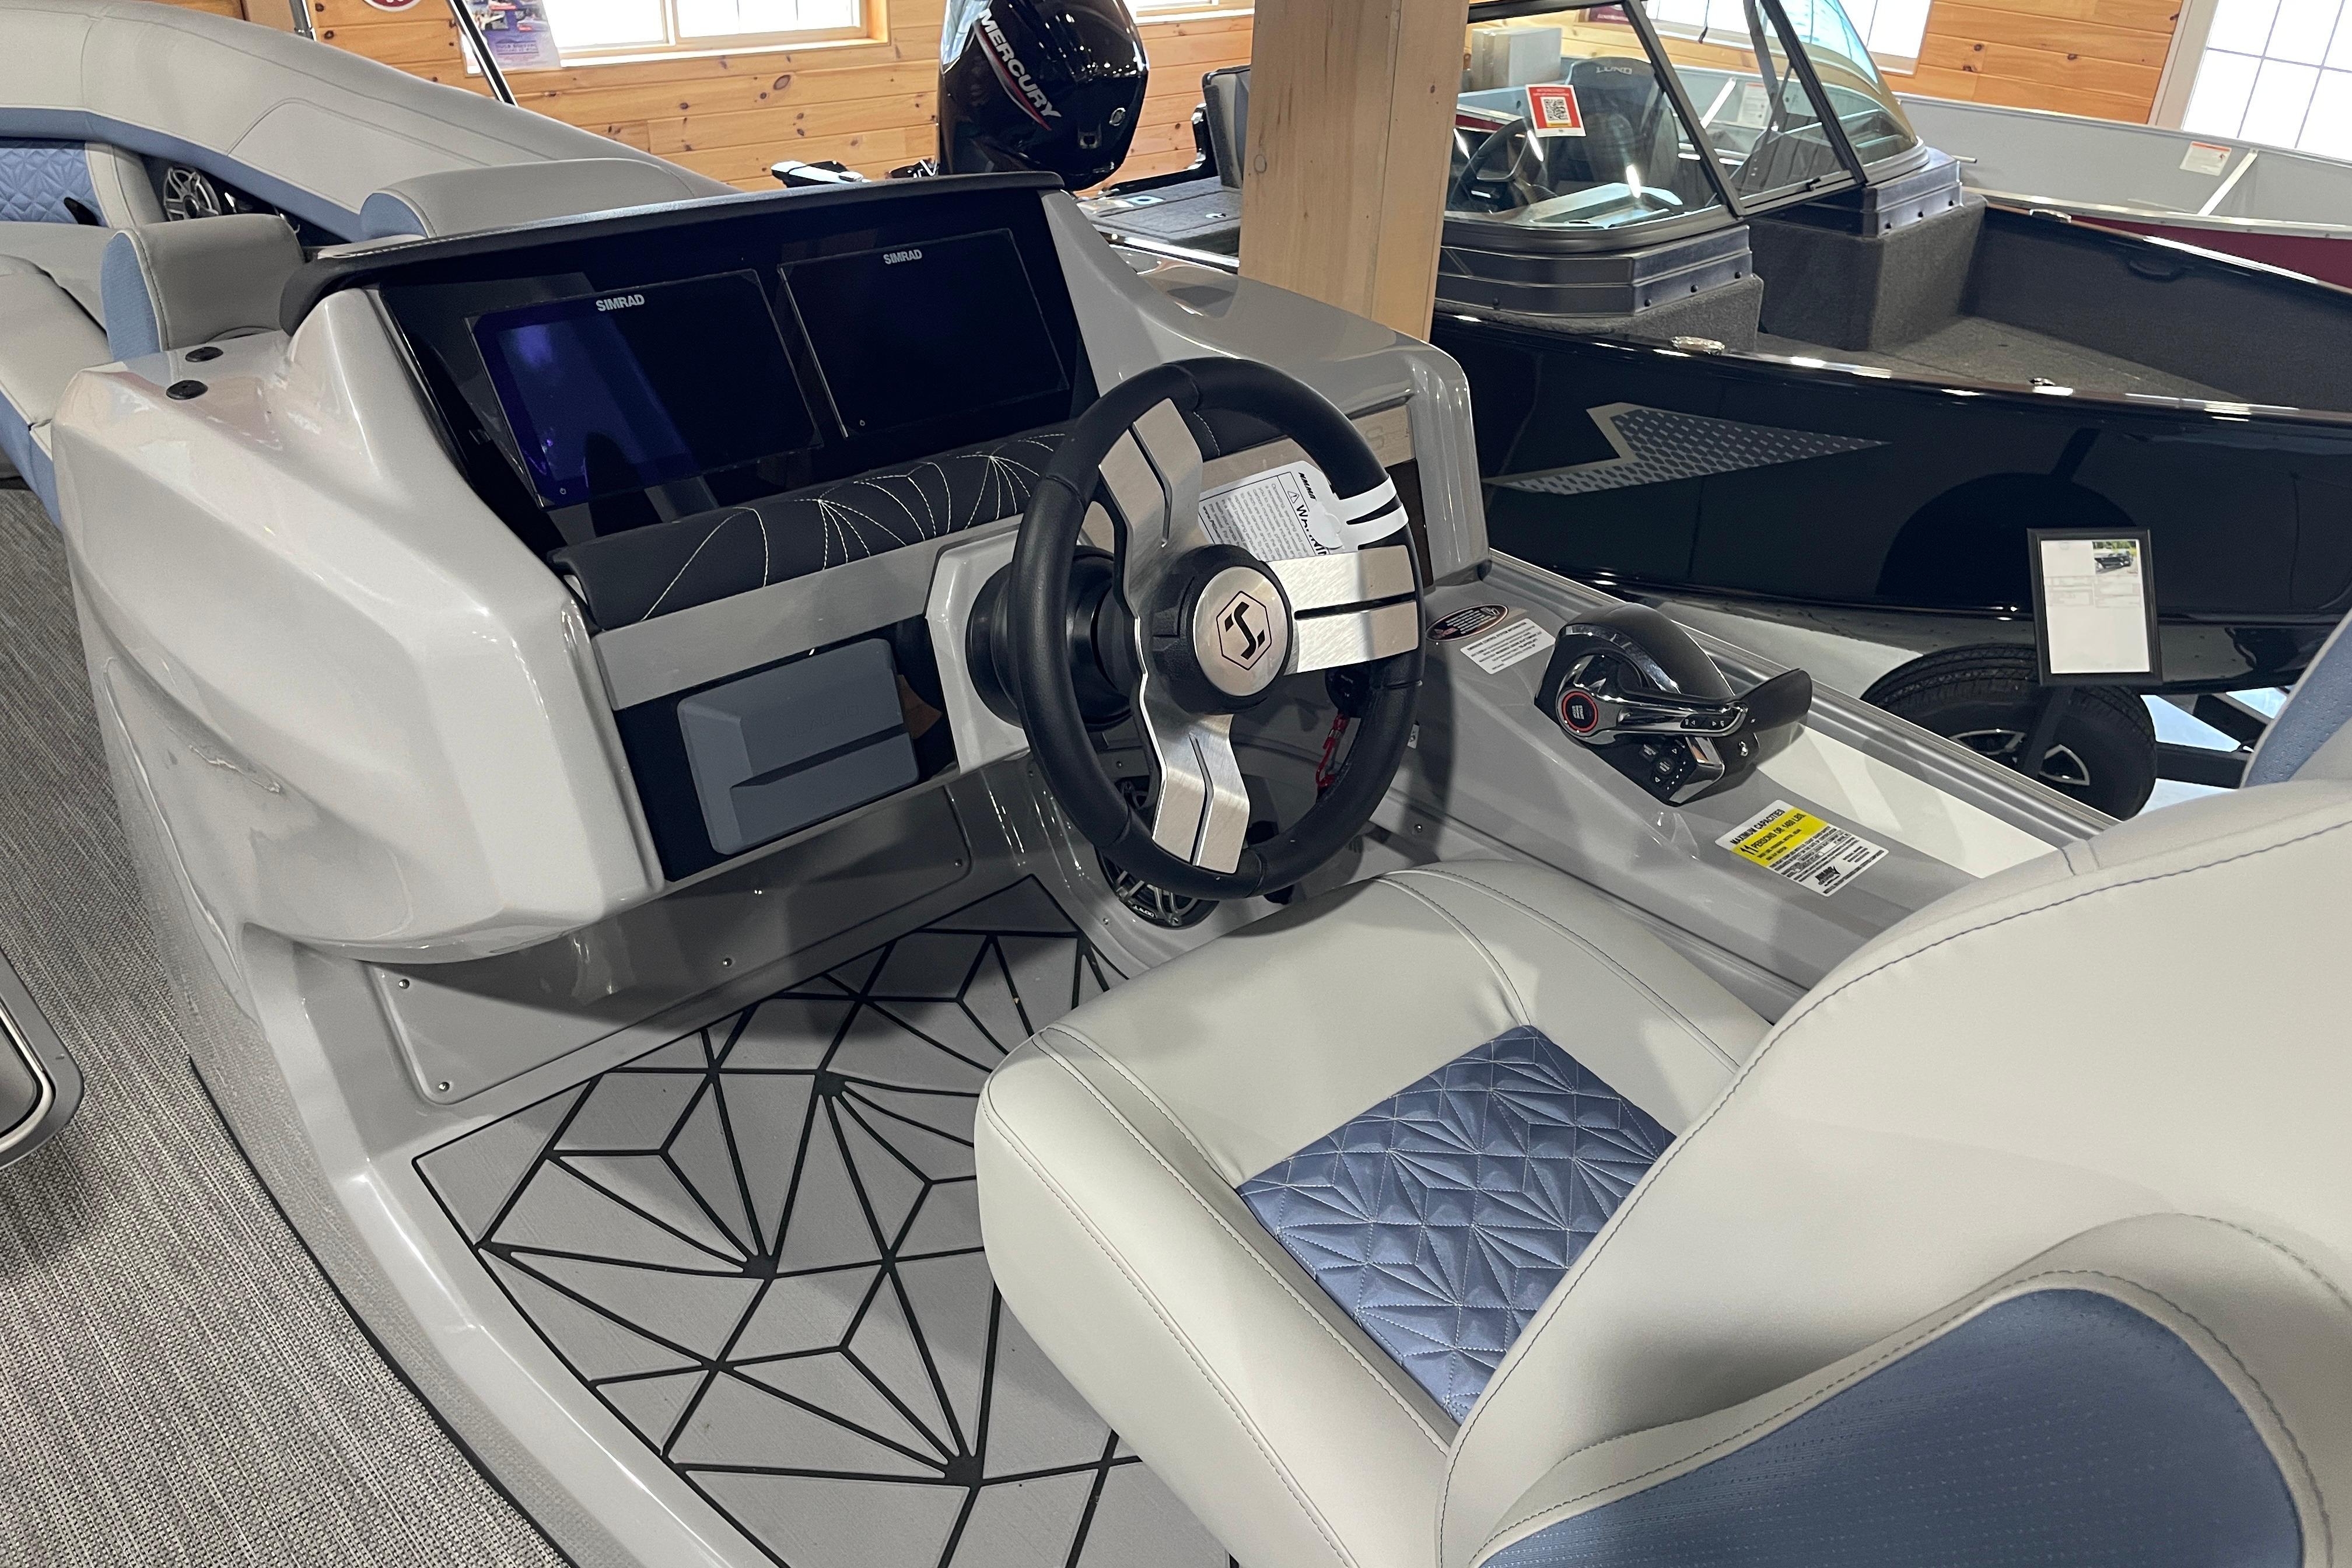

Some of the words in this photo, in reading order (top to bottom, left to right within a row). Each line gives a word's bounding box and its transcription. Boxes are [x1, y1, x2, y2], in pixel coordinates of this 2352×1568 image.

[976, 8, 1062, 117] MERCURY
[1596, 66, 1633, 75] LUND
[883, 249, 922, 264] SIMRAD
[596, 294, 645, 312] SIMRAD
[1731, 828, 1757, 844] MAXIMUM
[1741, 845, 1755, 855] 11
[1752, 832, 1776, 848] PERSONS
